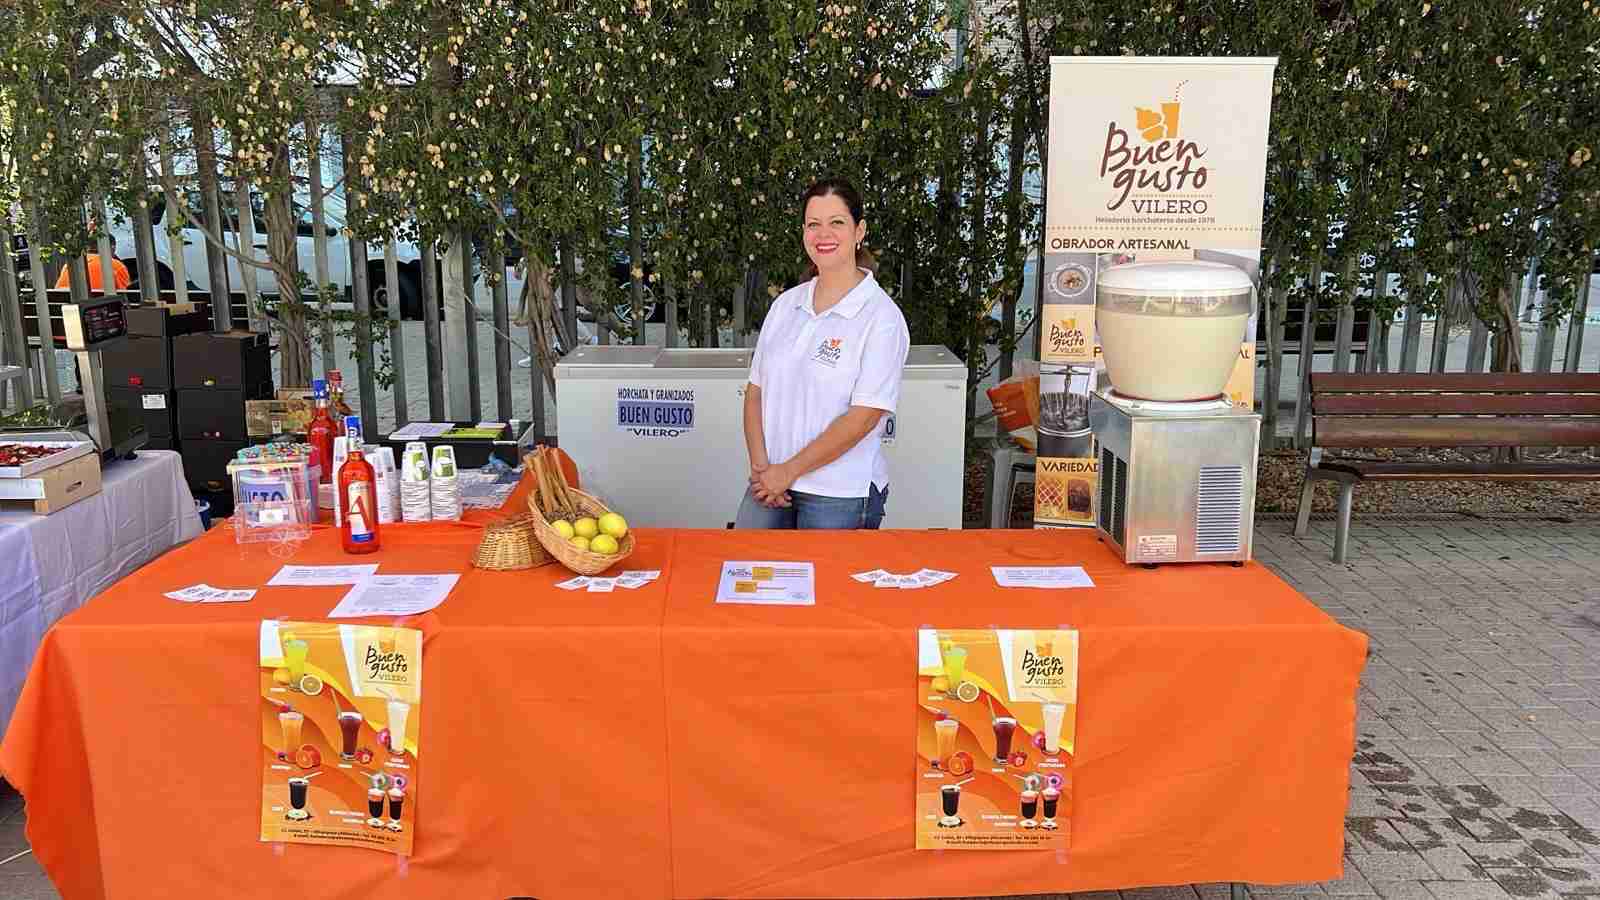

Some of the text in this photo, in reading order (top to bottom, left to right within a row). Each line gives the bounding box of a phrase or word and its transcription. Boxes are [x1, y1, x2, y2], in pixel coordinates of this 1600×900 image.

[1100, 121, 1208, 177] Buen
[1107, 155, 1208, 211] gusto
[1131, 199, 1208, 214] VILERO
[1051, 238, 1191, 250] OBRADOR ARTESANAL
[1049, 323, 1083, 341] Buen
[1052, 336, 1085, 352] gusto
[617, 387, 694, 401] HORCHATA Y GRANIZADOS
[620, 406, 693, 425] BUEN GUSTO
[365, 645, 406, 664] Buen
[1022, 650, 1062, 670] Buen
[369, 660, 408, 679] gusto
[1025, 663, 1064, 684] gusto
